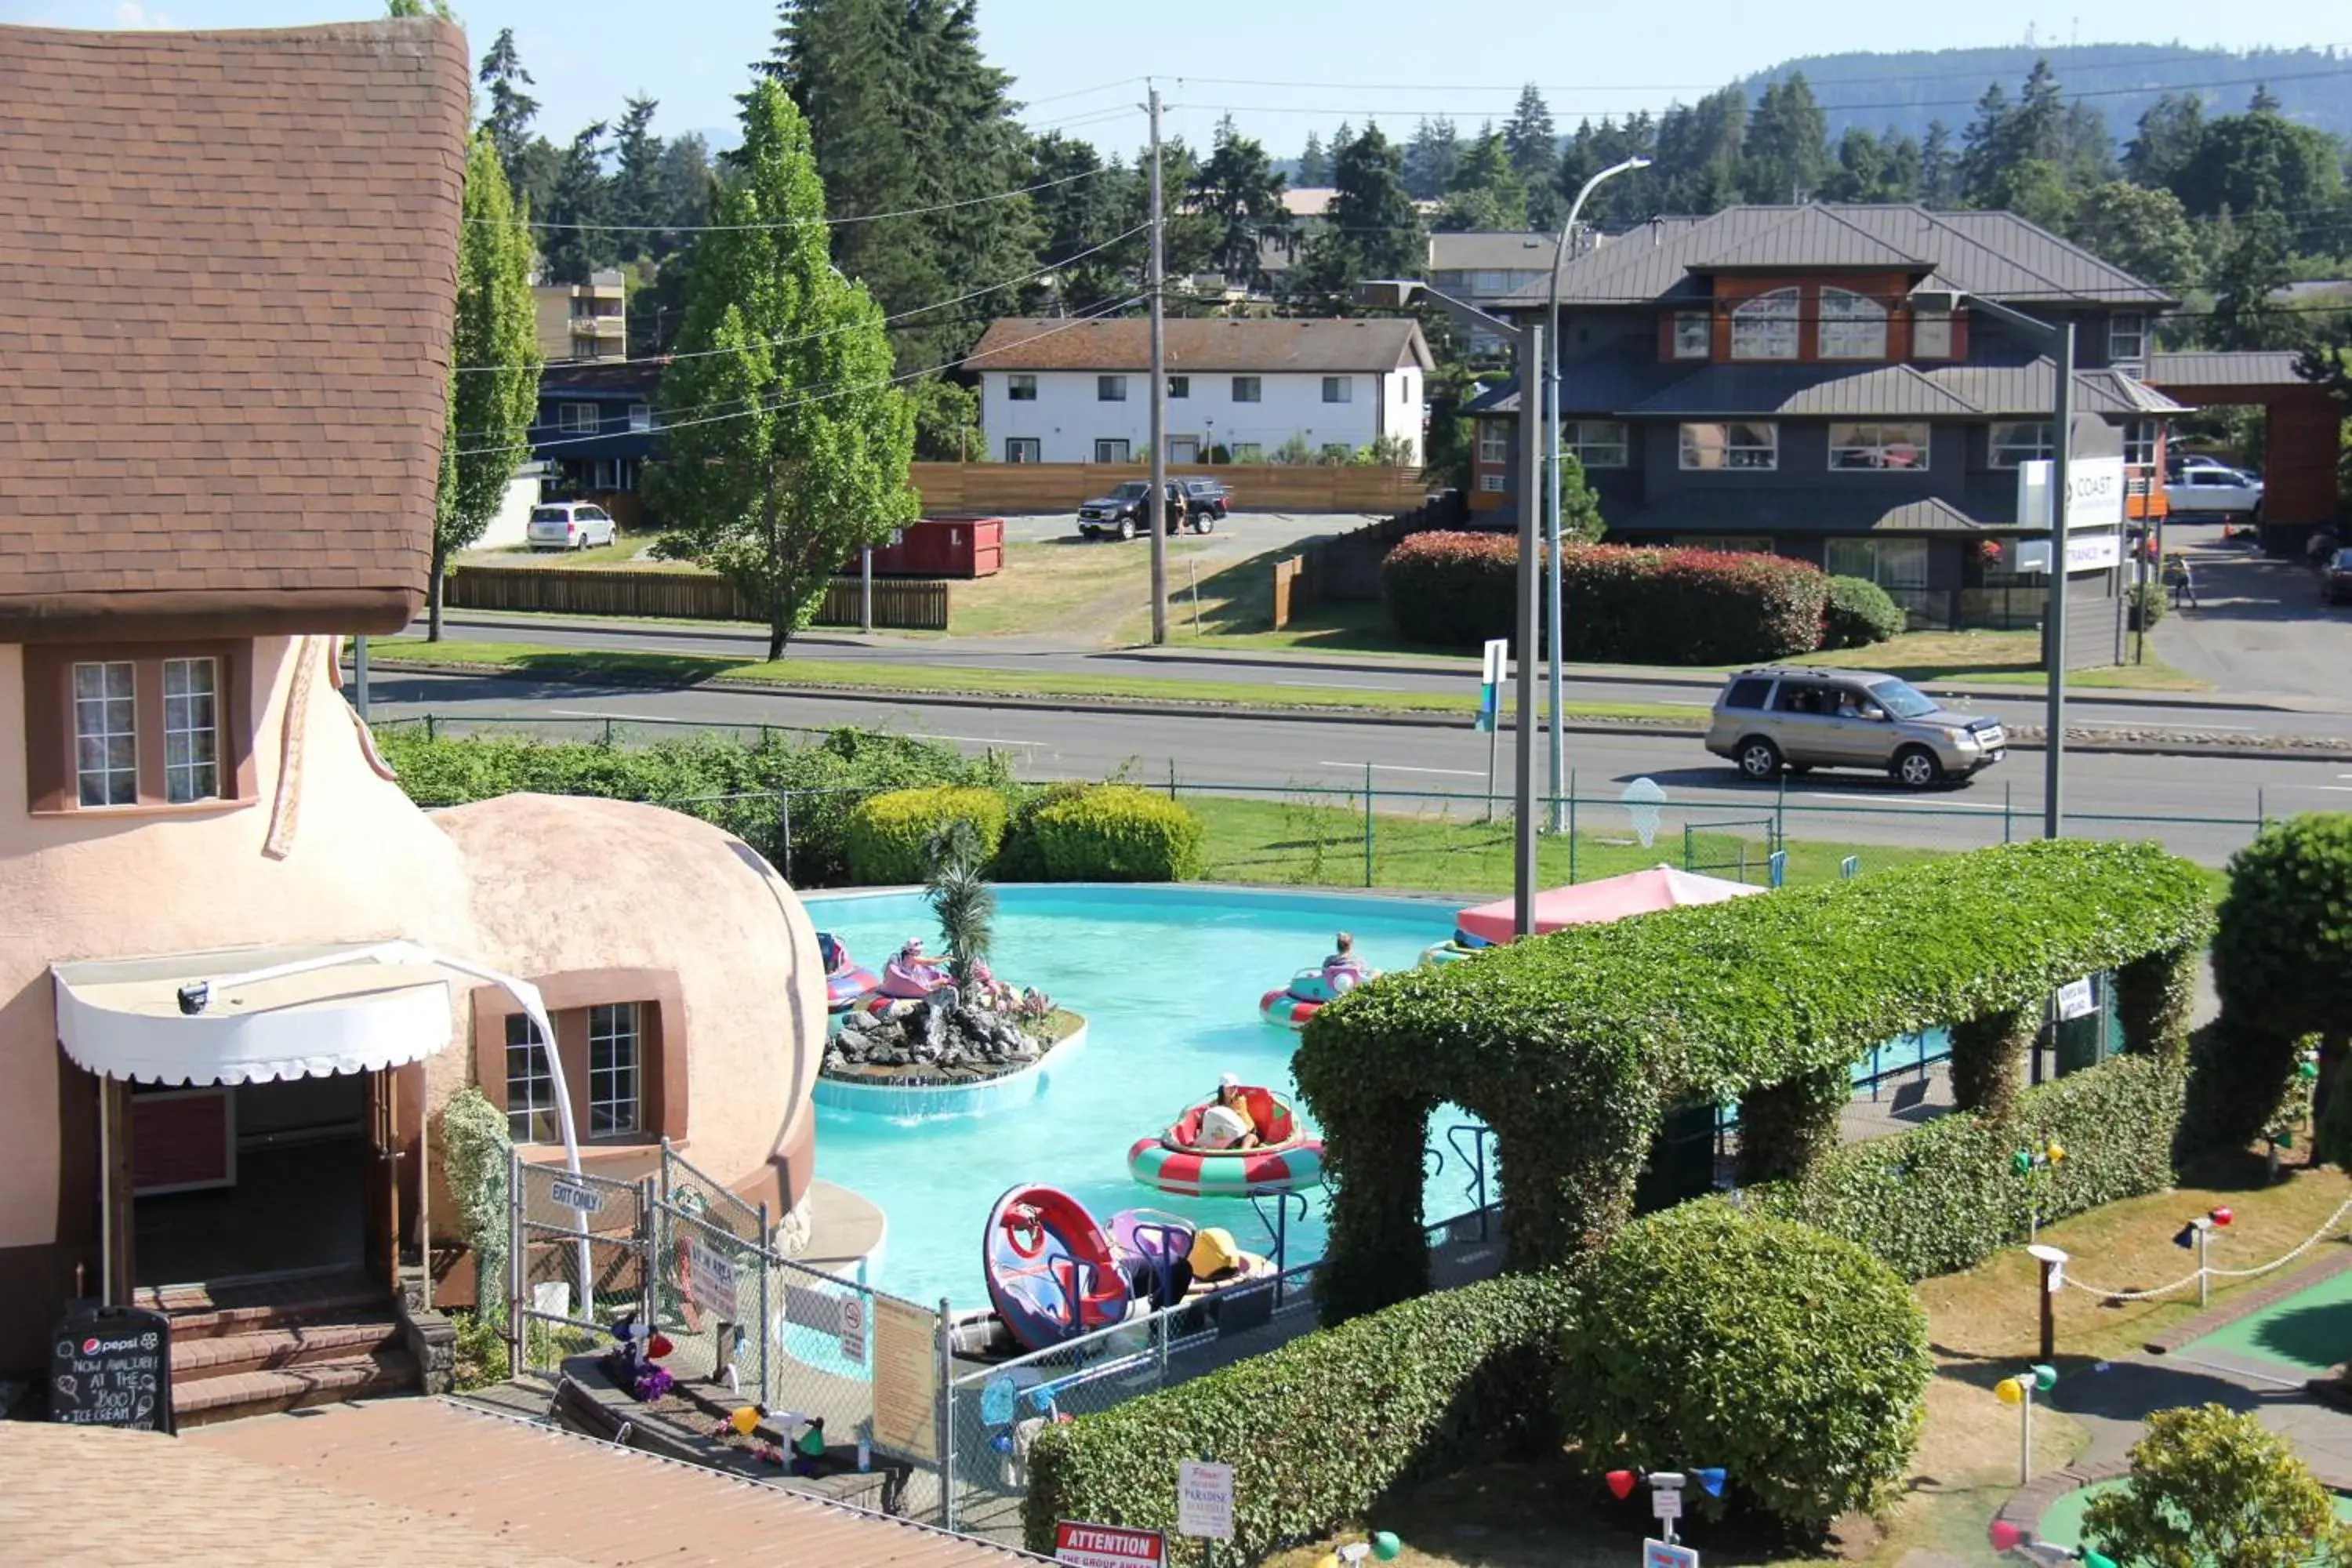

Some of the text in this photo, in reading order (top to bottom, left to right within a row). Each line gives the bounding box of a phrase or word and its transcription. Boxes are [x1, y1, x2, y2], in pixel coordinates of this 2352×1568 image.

[2078, 477, 2113, 496] COAST
[553, 1183, 598, 1210] EXIT ONLY
[103, 1338, 138, 1352] pepsi
[73, 1359, 102, 1373] NOW
[90, 1371, 139, 1388] AT THE
[72, 1408, 129, 1421] ICE CREAM
[1067, 1530, 1150, 1555] ATTENTION
